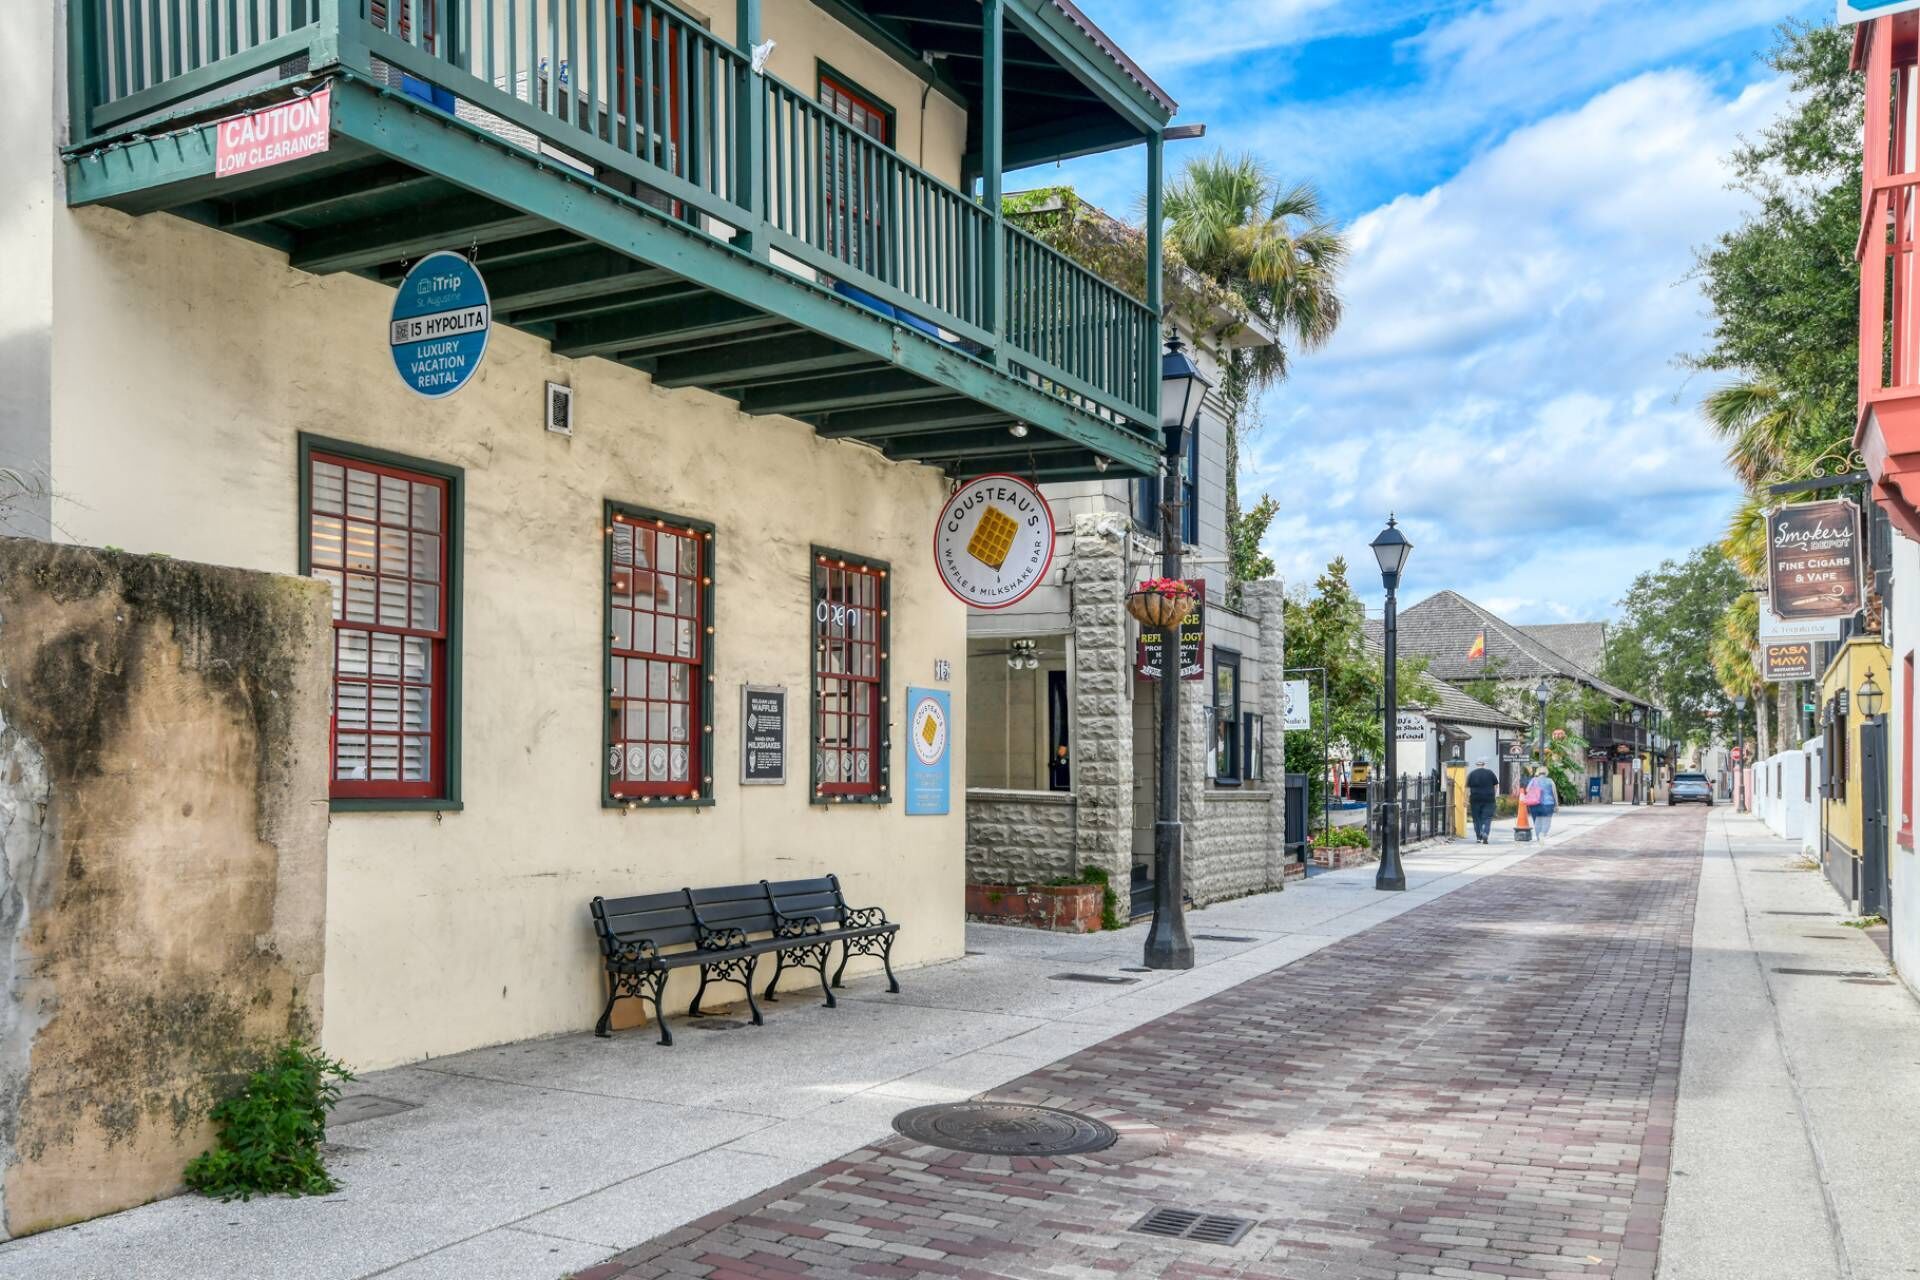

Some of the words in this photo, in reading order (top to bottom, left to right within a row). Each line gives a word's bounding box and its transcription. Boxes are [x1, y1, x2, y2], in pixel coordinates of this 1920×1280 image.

[225, 98, 320, 148] CAUTION
[219, 151, 246, 172] LOW
[249, 131, 325, 164] CLEARANCE
[433, 273, 461, 292] iTrip
[411, 322, 422, 337] 15
[427, 311, 483, 334] HYPOLITA
[418, 341, 460, 359] LUXURY
[411, 355, 465, 374] VACATION
[418, 370, 458, 388] RENTAL
[948, 487, 1039, 533] COUSTEAU'S
[1774, 520, 1853, 548] Smokers
[1810, 538, 1850, 551] DEPOT
[945, 548, 968, 588] WAFFLE
[980, 566, 1034, 596] MILKSHAKE
[1031, 541, 1041, 563] BAR
[1779, 560, 1804, 572] FINE
[1808, 557, 1850, 569] CIGARS
[1795, 574, 1804, 583] &
[1807, 572, 1837, 583] VAPE
[1769, 646, 1808, 656] CASA
[1770, 656, 1807, 666] MAYA
[752, 704, 778, 712] WAFFLES
[747, 741, 781, 749] MILKSHAKES
